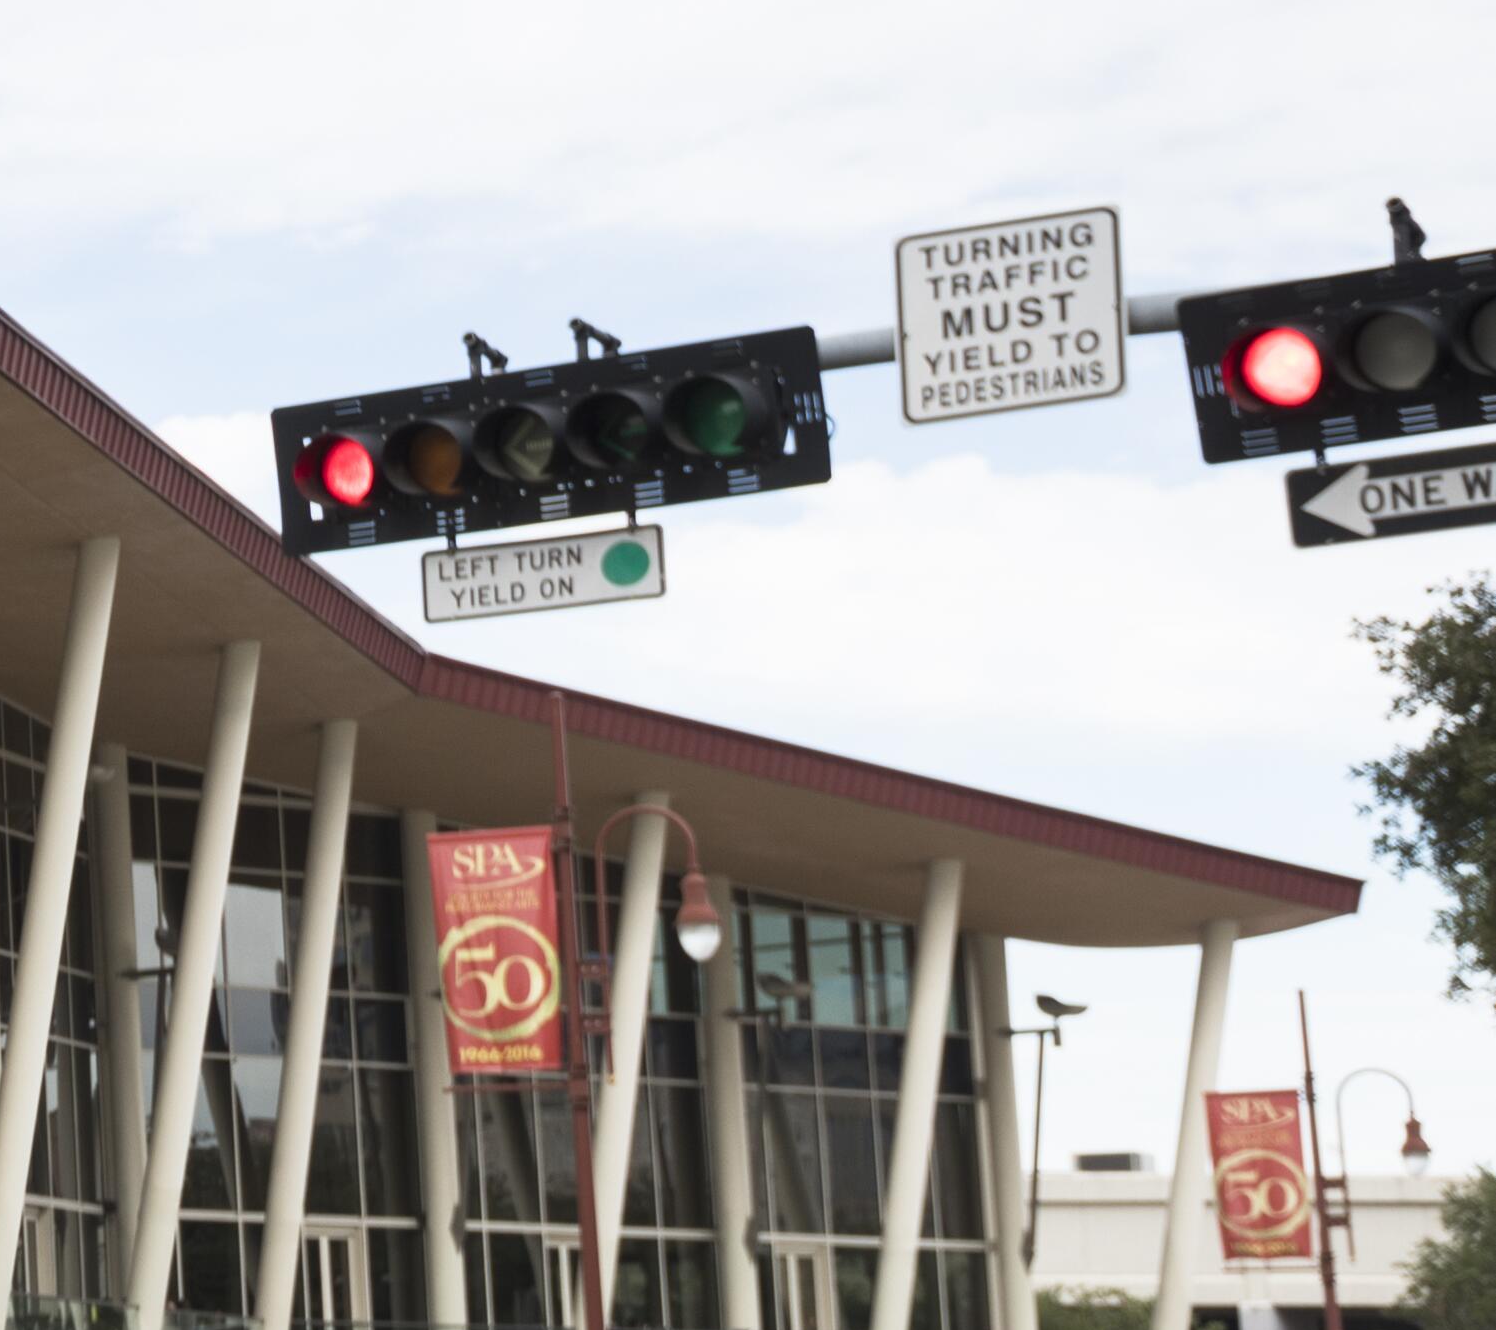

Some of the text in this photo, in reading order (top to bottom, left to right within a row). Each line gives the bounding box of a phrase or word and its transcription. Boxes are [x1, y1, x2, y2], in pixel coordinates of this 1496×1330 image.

[919, 222, 1093, 270] TURNING
[926, 255, 1088, 300] TRAFFIC
[941, 290, 1075, 340] MUST
[923, 329, 1099, 376] YIELD TO
[921, 360, 1104, 409] PEDESTRIANS
[1361, 475, 1447, 514] ONE
[438, 544, 583, 582] LEFT TURN
[450, 576, 574, 609] YIELD ON
[453, 843, 522, 878] SPA
[455, 941, 545, 1018] 50
[1223, 1171, 1298, 1223] 50
